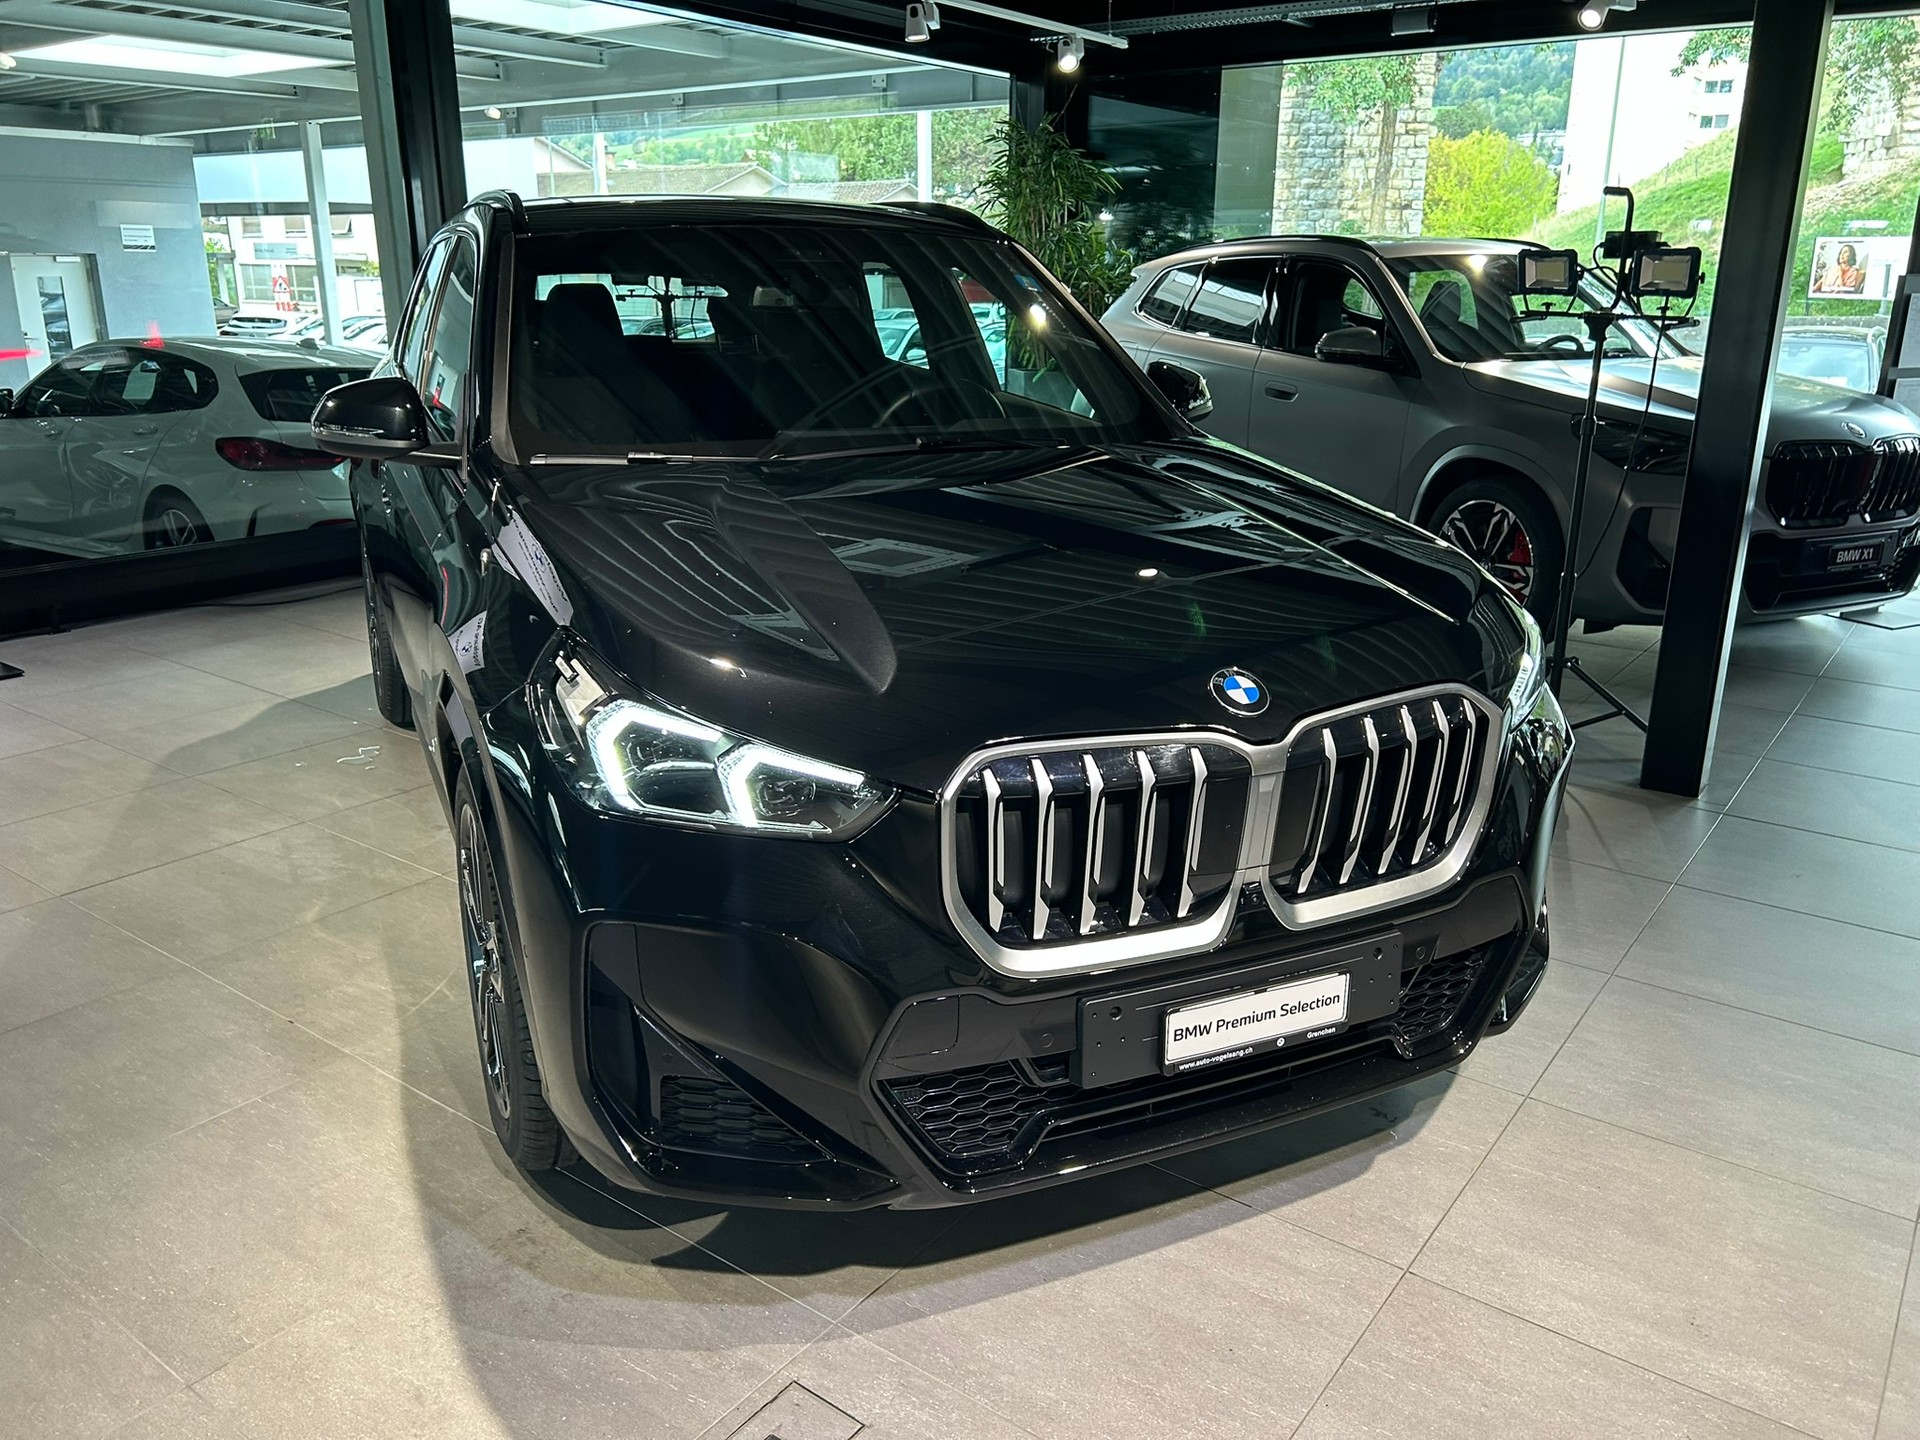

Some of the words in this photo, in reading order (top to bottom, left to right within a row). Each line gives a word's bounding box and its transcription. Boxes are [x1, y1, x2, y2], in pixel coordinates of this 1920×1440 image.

[1836, 548, 1862, 563] BMW
[1861, 547, 1874, 560] X1
[1173, 1021, 1213, 1043] BMW
[1216, 1008, 1277, 1033] Premium
[1280, 994, 1341, 1017] Selection
[1178, 1046, 1254, 1071] www.auto-vogelsang.ch
[1306, 1026, 1336, 1039] Grenchen
